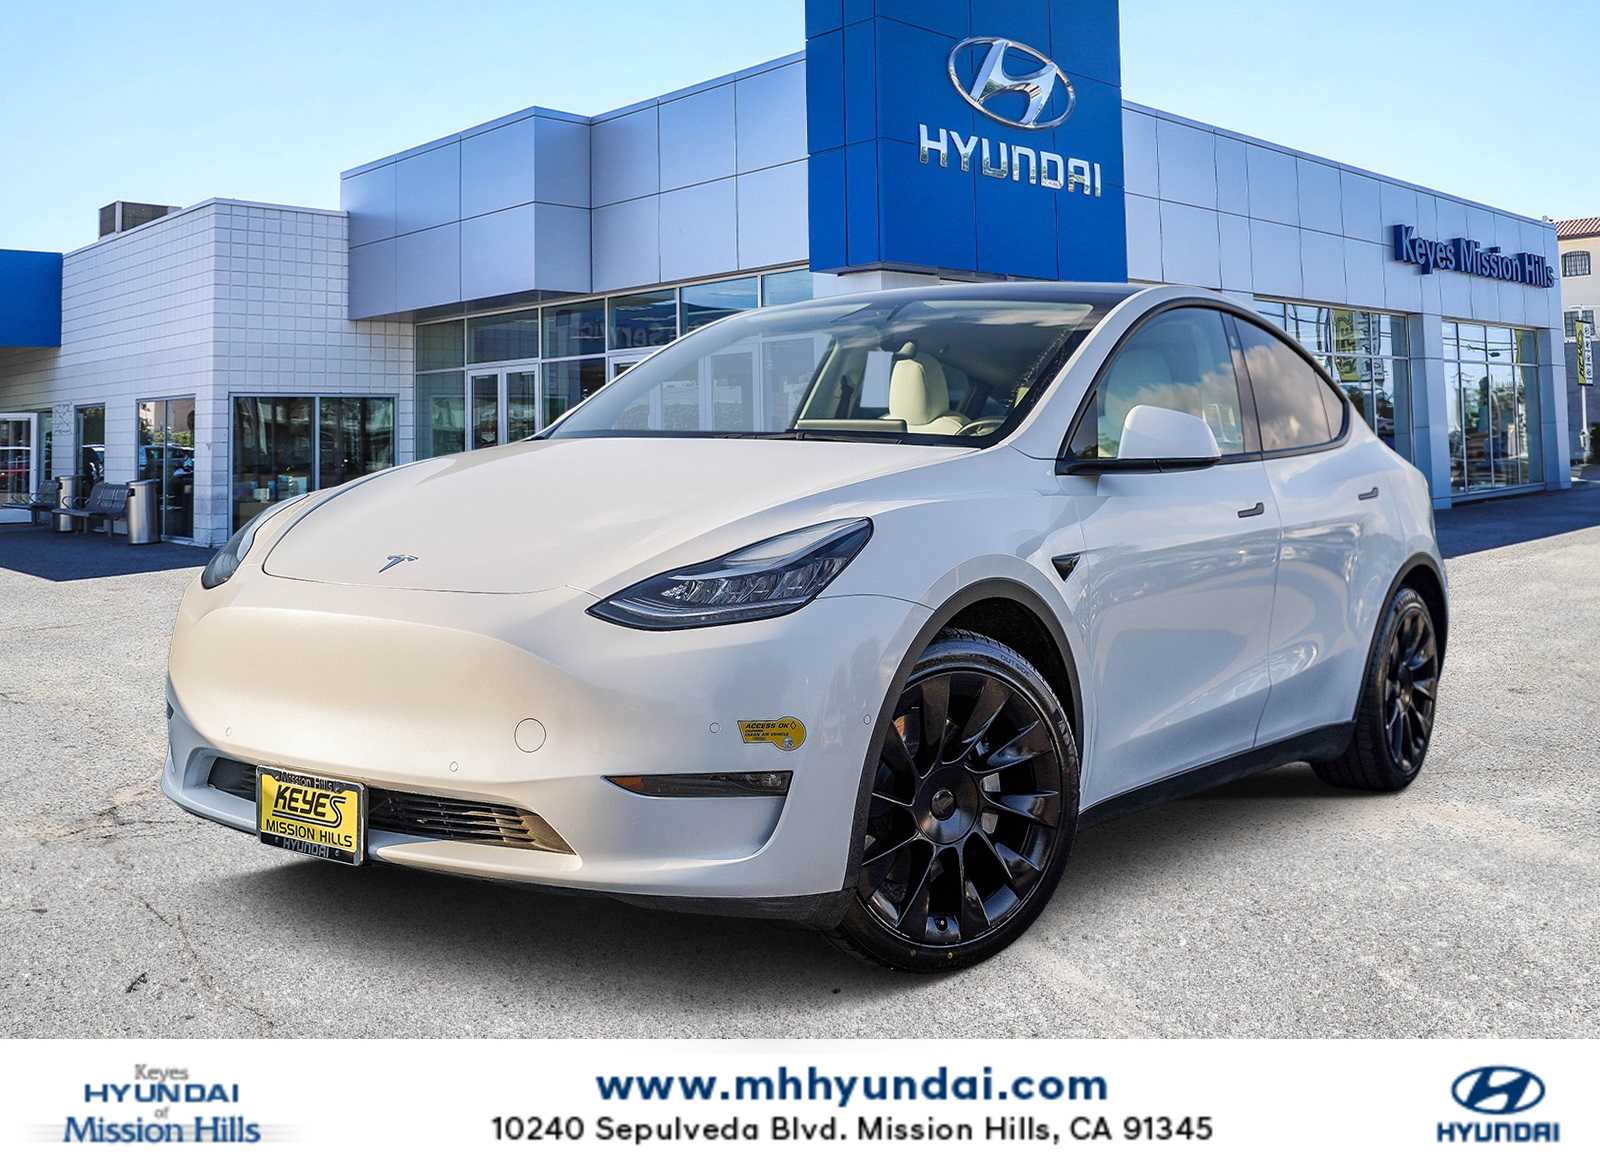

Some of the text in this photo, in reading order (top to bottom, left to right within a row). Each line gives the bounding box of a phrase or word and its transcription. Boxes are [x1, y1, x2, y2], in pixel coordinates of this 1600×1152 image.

[919, 123, 1102, 198] HYUNDAI
[1394, 224, 1555, 288] Keyes Mission Hills
[272, 784, 347, 828] KEYES
[266, 819, 353, 848] MISSION HILLS
[283, 838, 329, 858] HYUNDAI
